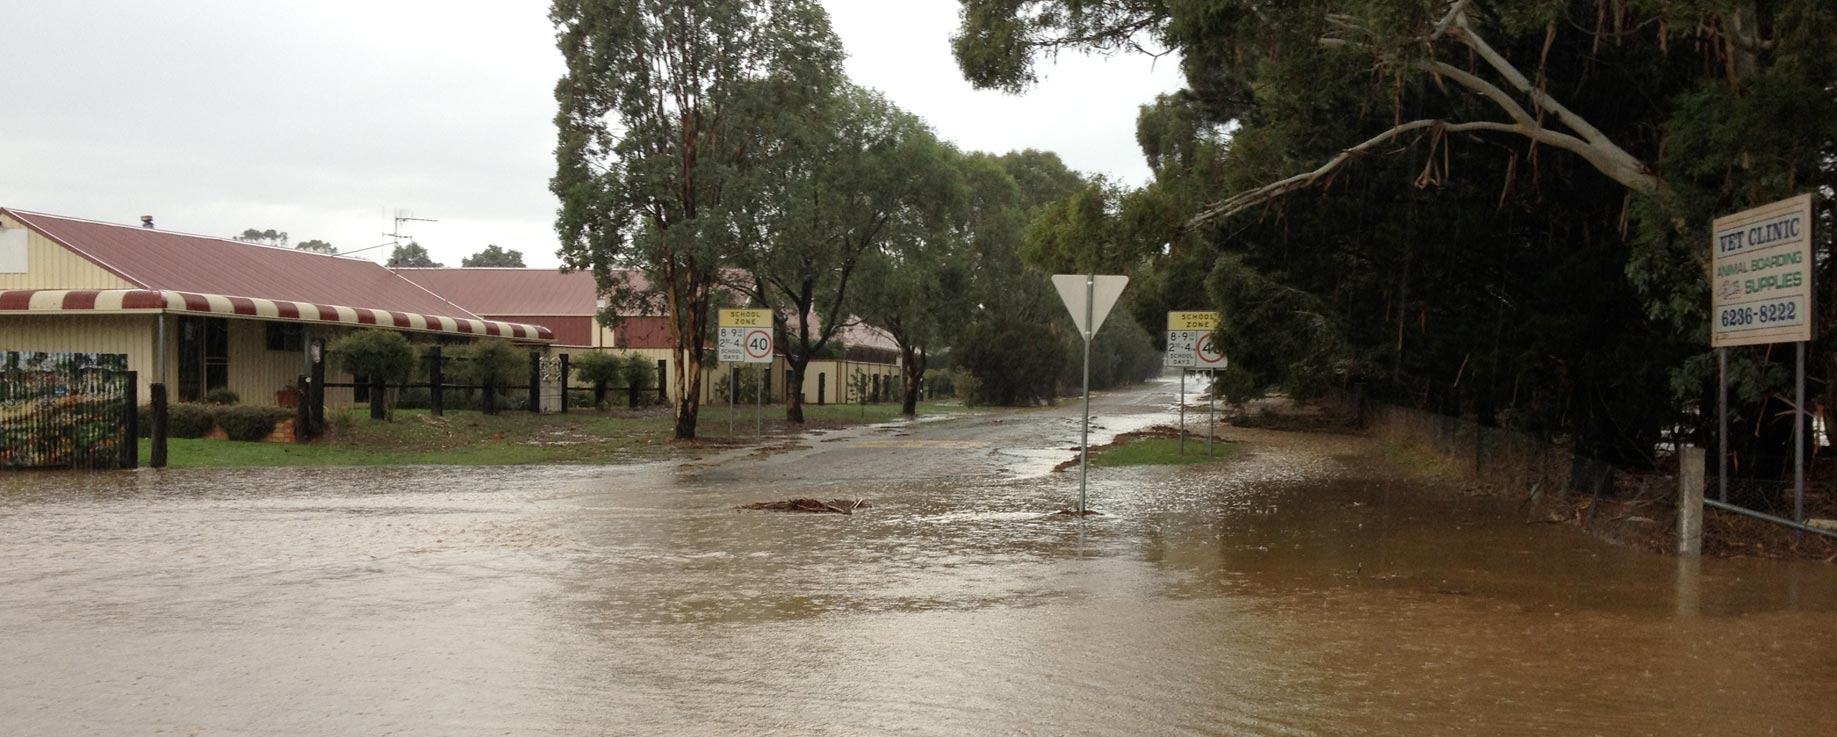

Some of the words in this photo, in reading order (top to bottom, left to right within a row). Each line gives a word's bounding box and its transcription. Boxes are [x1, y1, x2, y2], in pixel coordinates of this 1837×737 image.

[1719, 230, 1745, 252] VET
[1748, 217, 1800, 246] CLINIC
[1717, 262, 1748, 278] ANIMAL
[1750, 250, 1803, 272] BOARDING
[1745, 271, 1802, 294] SUPPLIES
[1721, 301, 1796, 327] 6236-8222
[750, 338, 768, 350] 40
